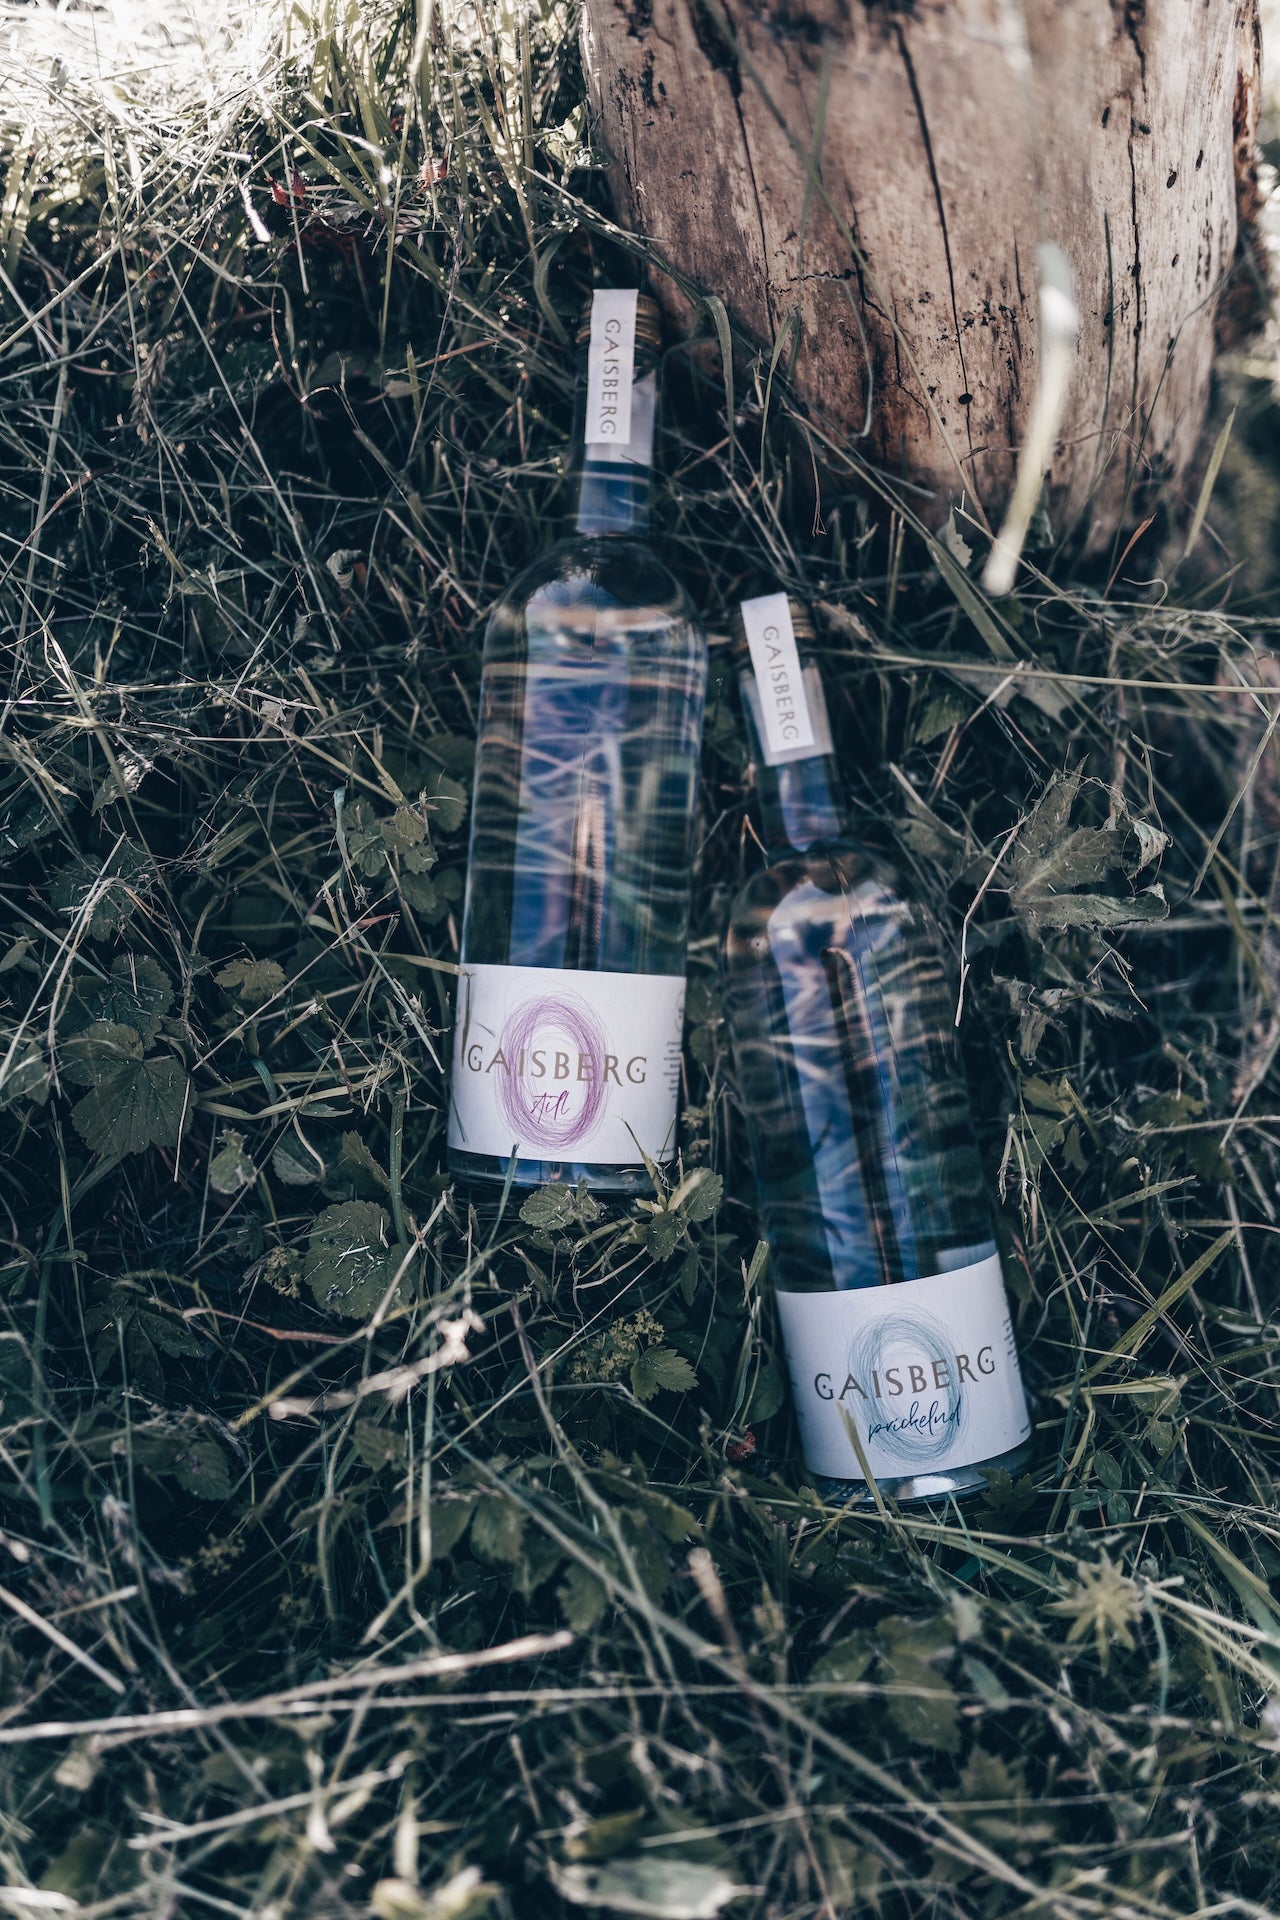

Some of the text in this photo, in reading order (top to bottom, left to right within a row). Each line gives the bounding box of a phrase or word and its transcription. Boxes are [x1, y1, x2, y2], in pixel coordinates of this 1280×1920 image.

[600, 320, 621, 434] GAISBERG
[763, 626, 799, 740] GAISBERG
[468, 1045, 647, 1087] GAISBERG
[530, 1090, 570, 1123] still
[814, 1346, 996, 1400] GAISBERG
[868, 1396, 961, 1443] prickelnd
